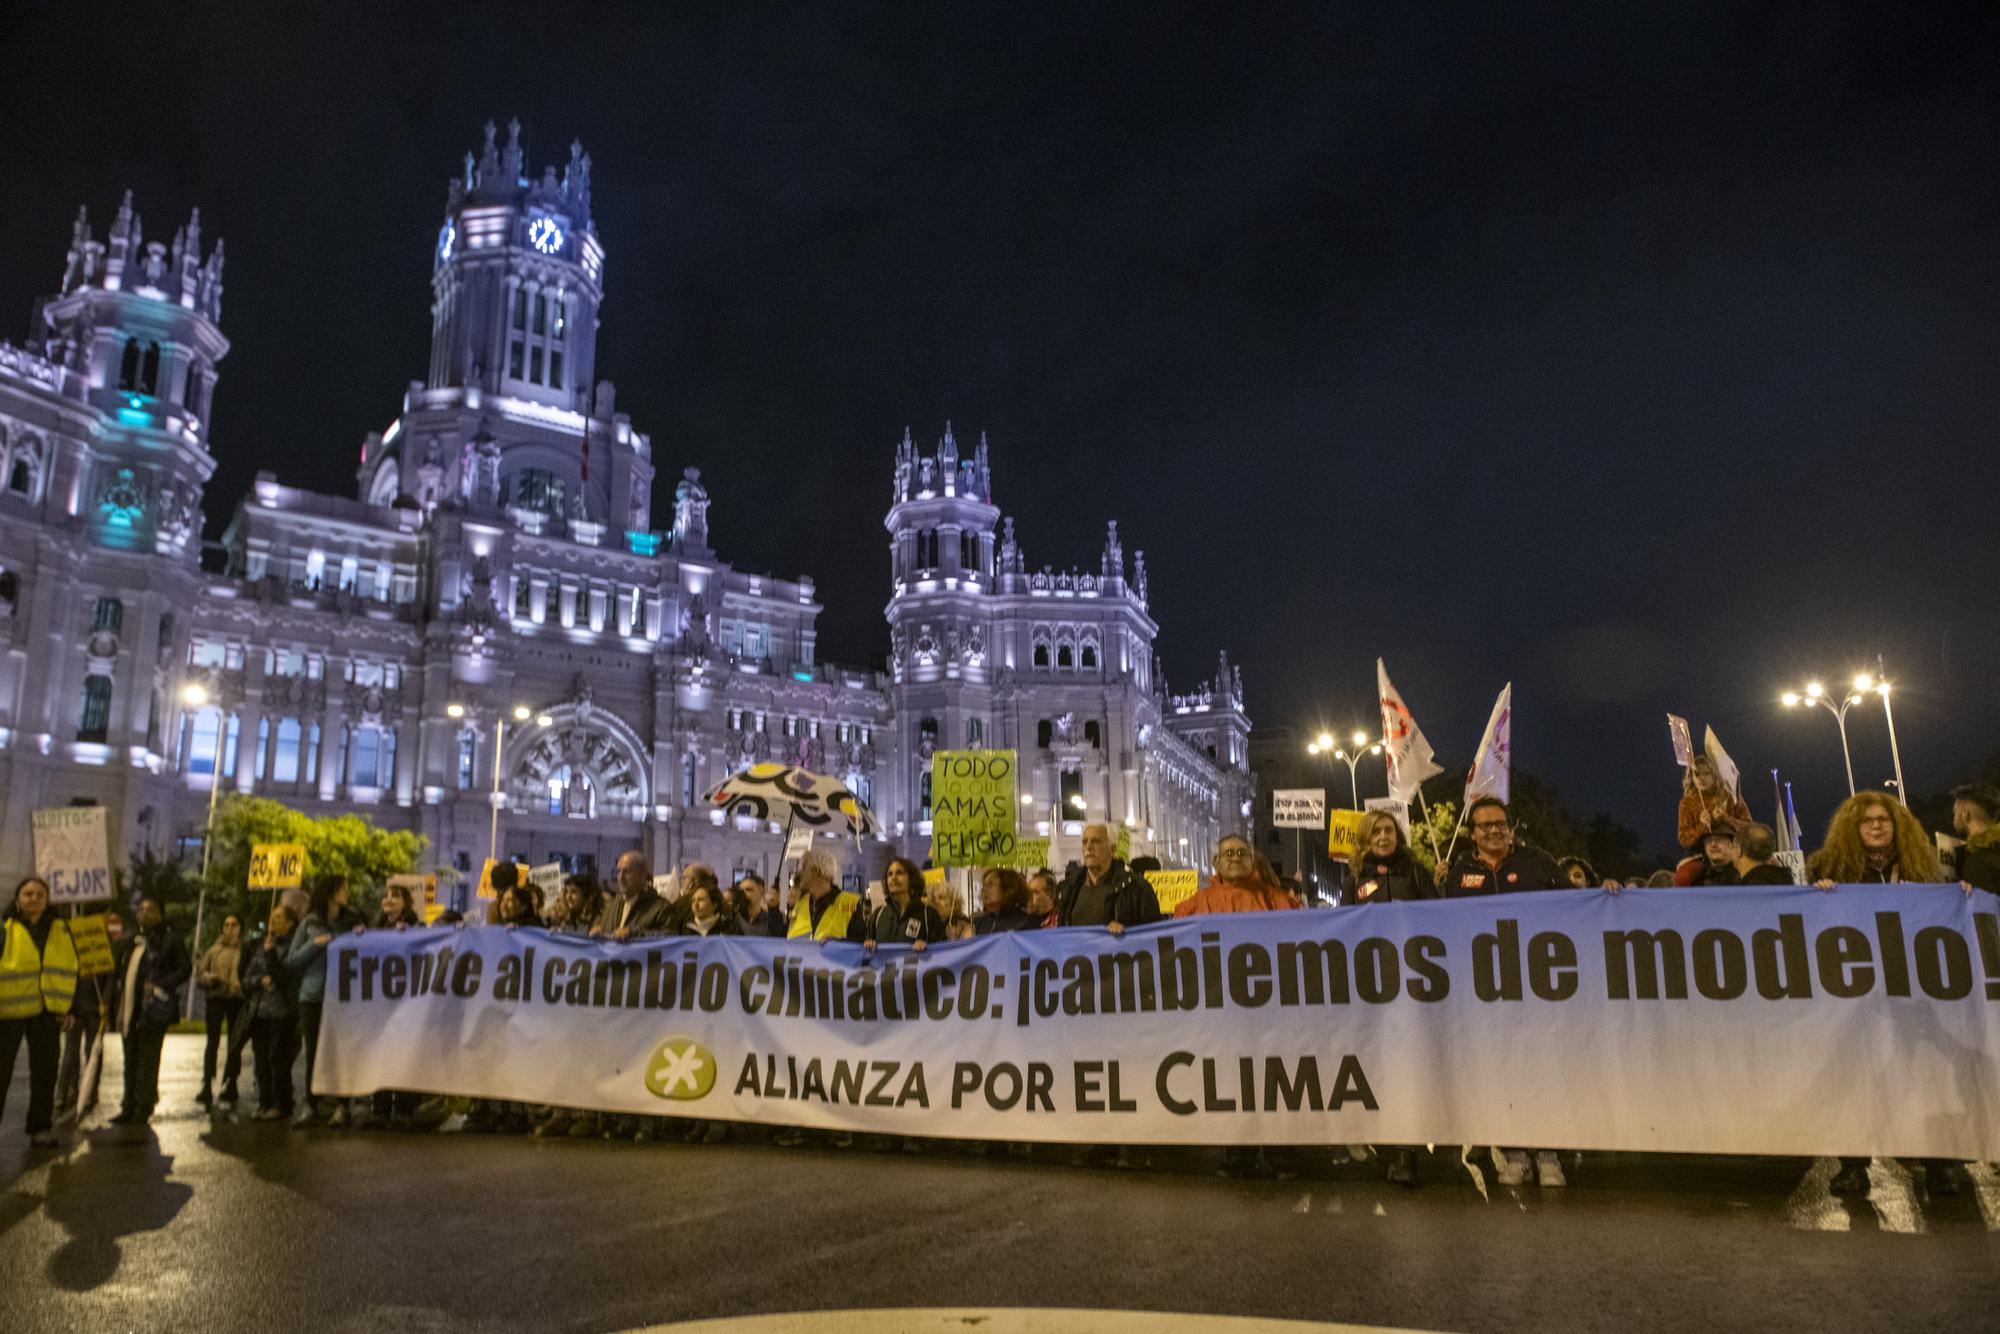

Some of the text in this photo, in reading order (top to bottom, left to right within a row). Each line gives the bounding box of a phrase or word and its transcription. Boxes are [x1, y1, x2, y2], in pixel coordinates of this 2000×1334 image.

[940, 757, 1009, 780] TODO
[935, 796, 1006, 818] AMAS
[1333, 825, 1346, 845] NO
[47, 868, 106, 897] EJOR
[337, 947, 481, 1002] Frente
[493, 947, 536, 1002] al
[541, 951, 728, 1012] cambio
[1016, 932, 1450, 1026] ¡cambiemos
[1471, 919, 1579, 1002] de
[1603, 911, 2000, 1002] modelo!
[733, 1050, 1380, 1115] ALIANZA POR EL CLIMA
